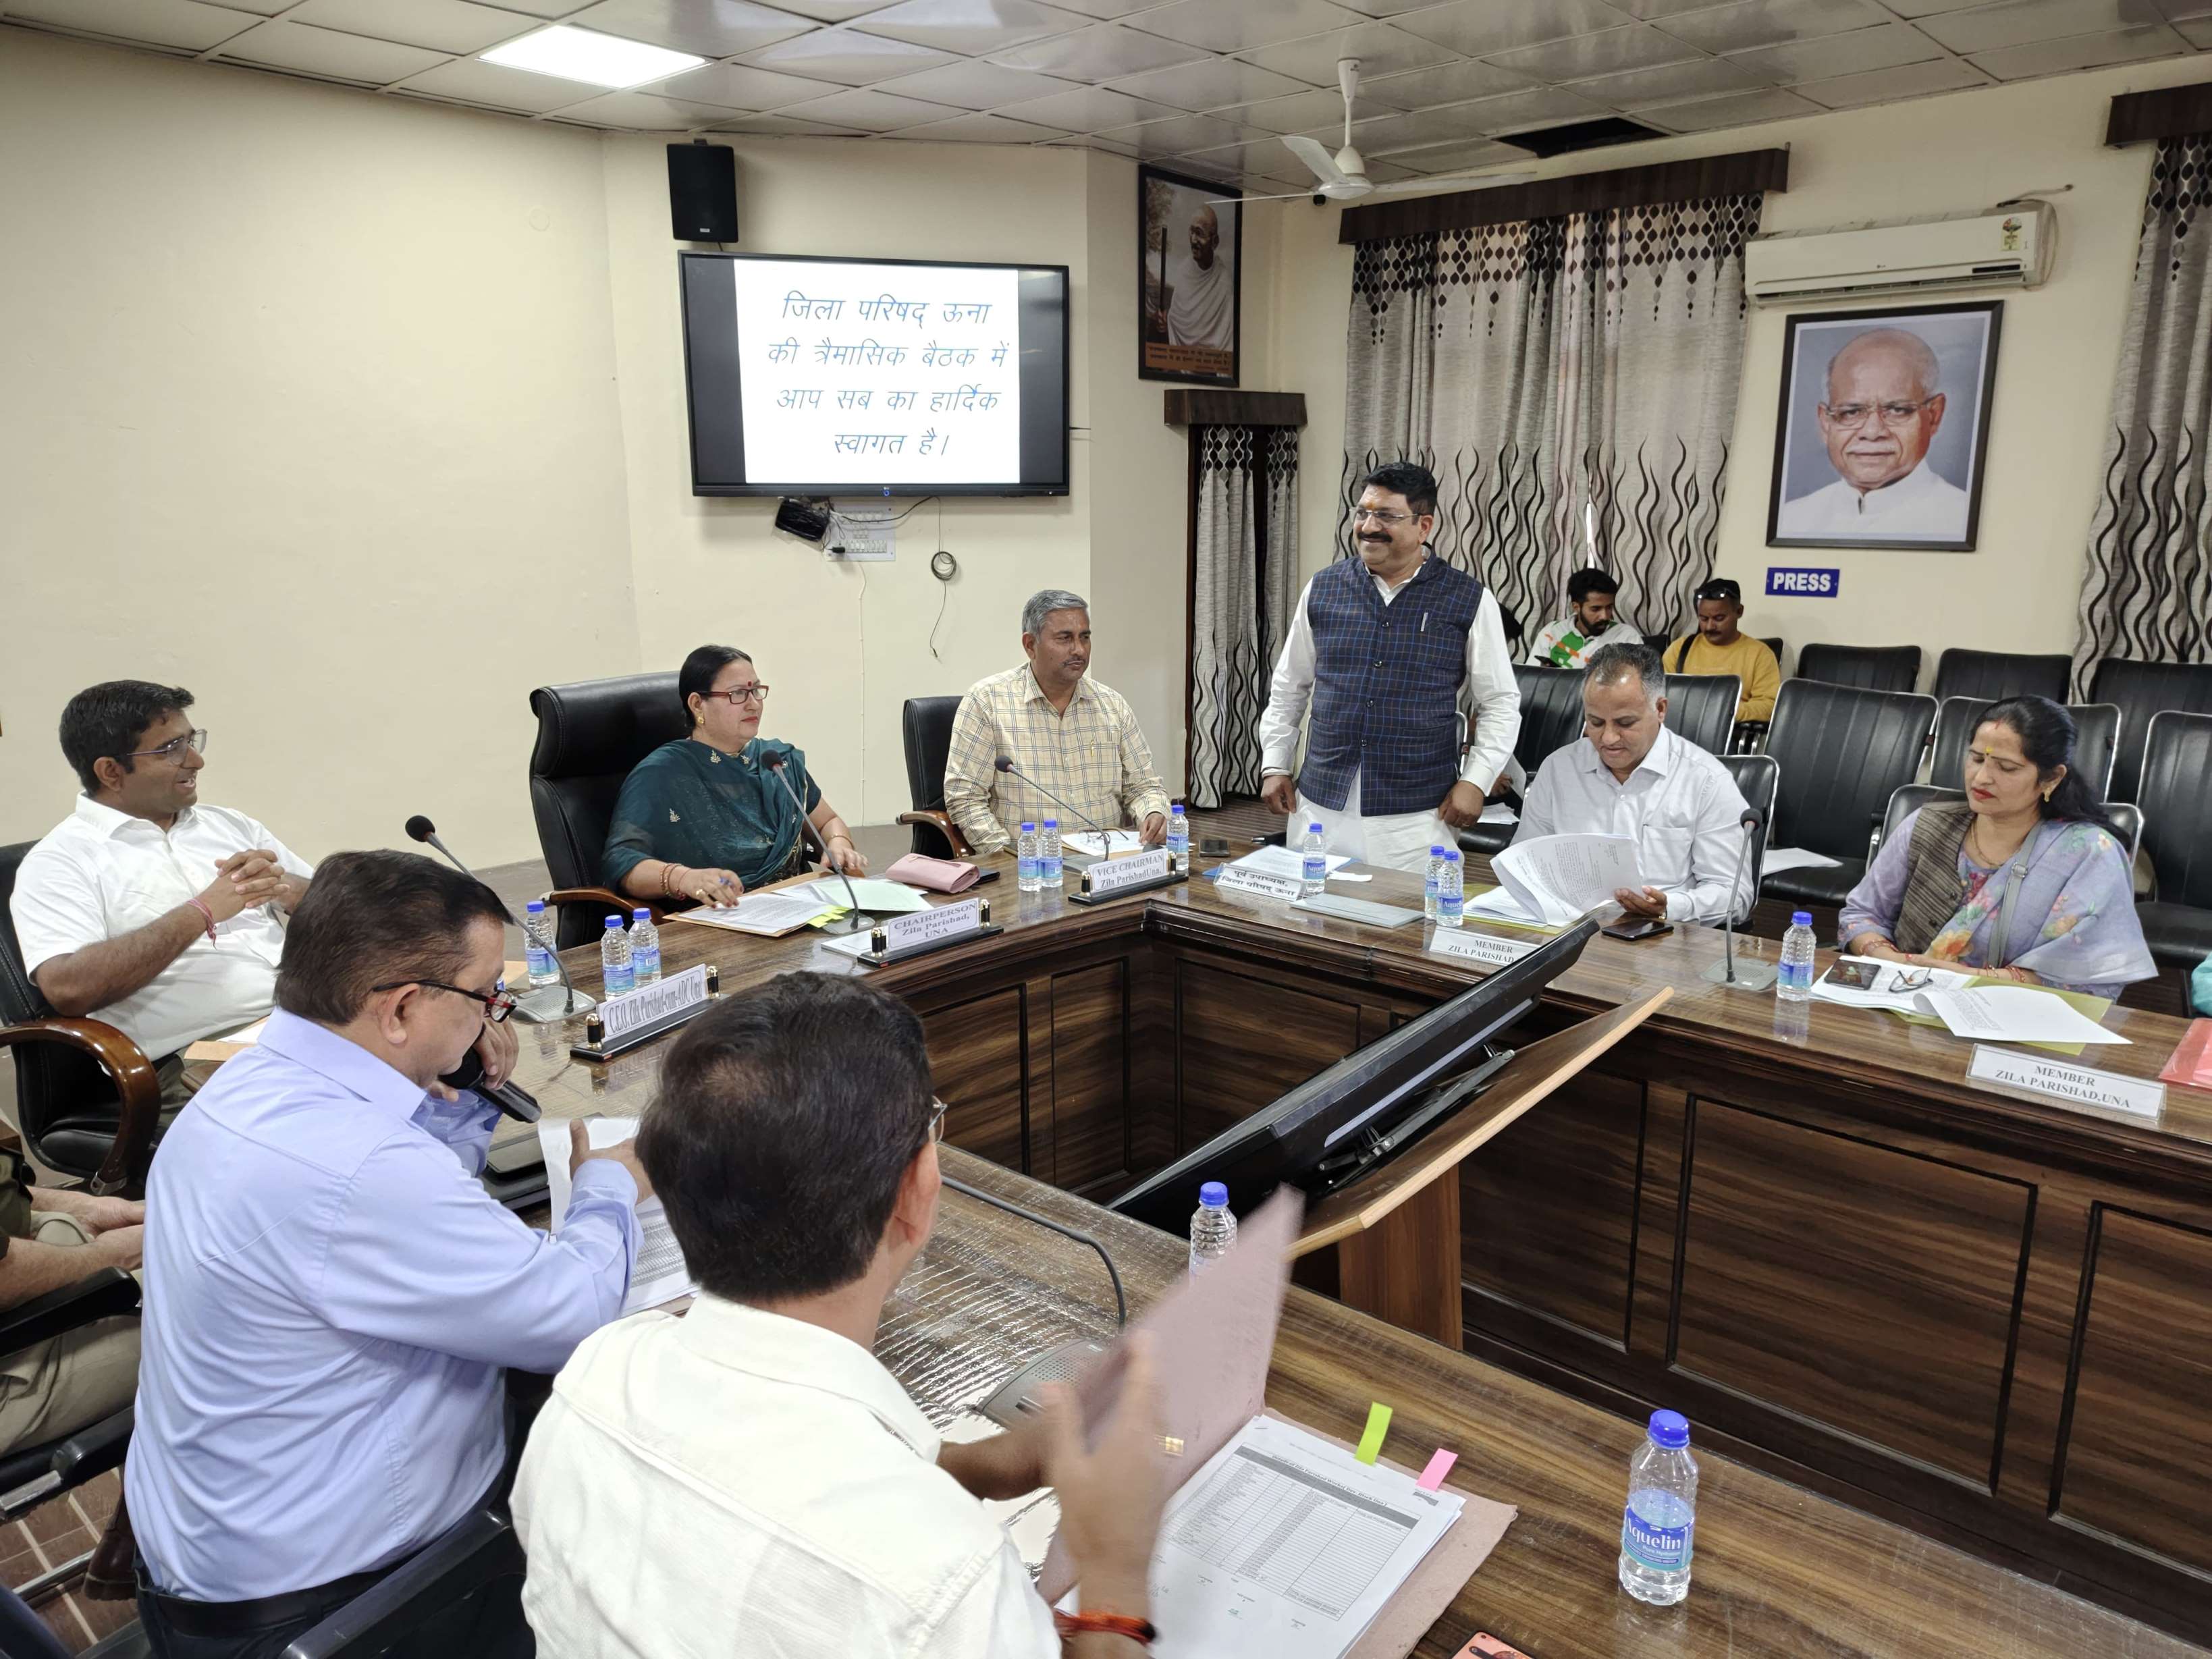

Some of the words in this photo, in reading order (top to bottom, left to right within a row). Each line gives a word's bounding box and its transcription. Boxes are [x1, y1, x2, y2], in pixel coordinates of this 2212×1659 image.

[782, 290, 846, 320] जिला
[859, 294, 930, 329] परिषद्
[943, 303, 993, 324] ऊना
[768, 337, 801, 364] की
[814, 337, 909, 366] त्रैमासिक
[922, 339, 979, 368] बैठक
[991, 340, 1010, 368] में
[776, 389, 824, 410] आप
[837, 390, 875, 410] सब
[887, 391, 919, 411] का
[929, 383, 1002, 413] हार्दिक
[834, 434, 908, 454] स्वागत
[1773, 572, 1831, 592] PRESS
[1097, 865, 1118, 877] VICE
[1119, 854, 1164, 871] CHAIRMAN
[1234, 869, 1247, 878] पूर्व
[1100, 879, 1115, 888] Zila
[1220, 875, 1243, 886] जिला
[1274, 886, 1296, 896] ऊना
[894, 902, 976, 930] CHAIRPERSON
[902, 927, 922, 936] Zila
[925, 927, 948, 938] UNA
[1447, 944, 1468, 955] ZILA
[1474, 939, 1513, 954] MEMBER
[609, 1002, 630, 1033] C.E.O.
[629, 998, 642, 1025] Zila
[1995, 1069, 2026, 1085] ZILA
[2034, 1065, 2096, 1087] MEMBER
